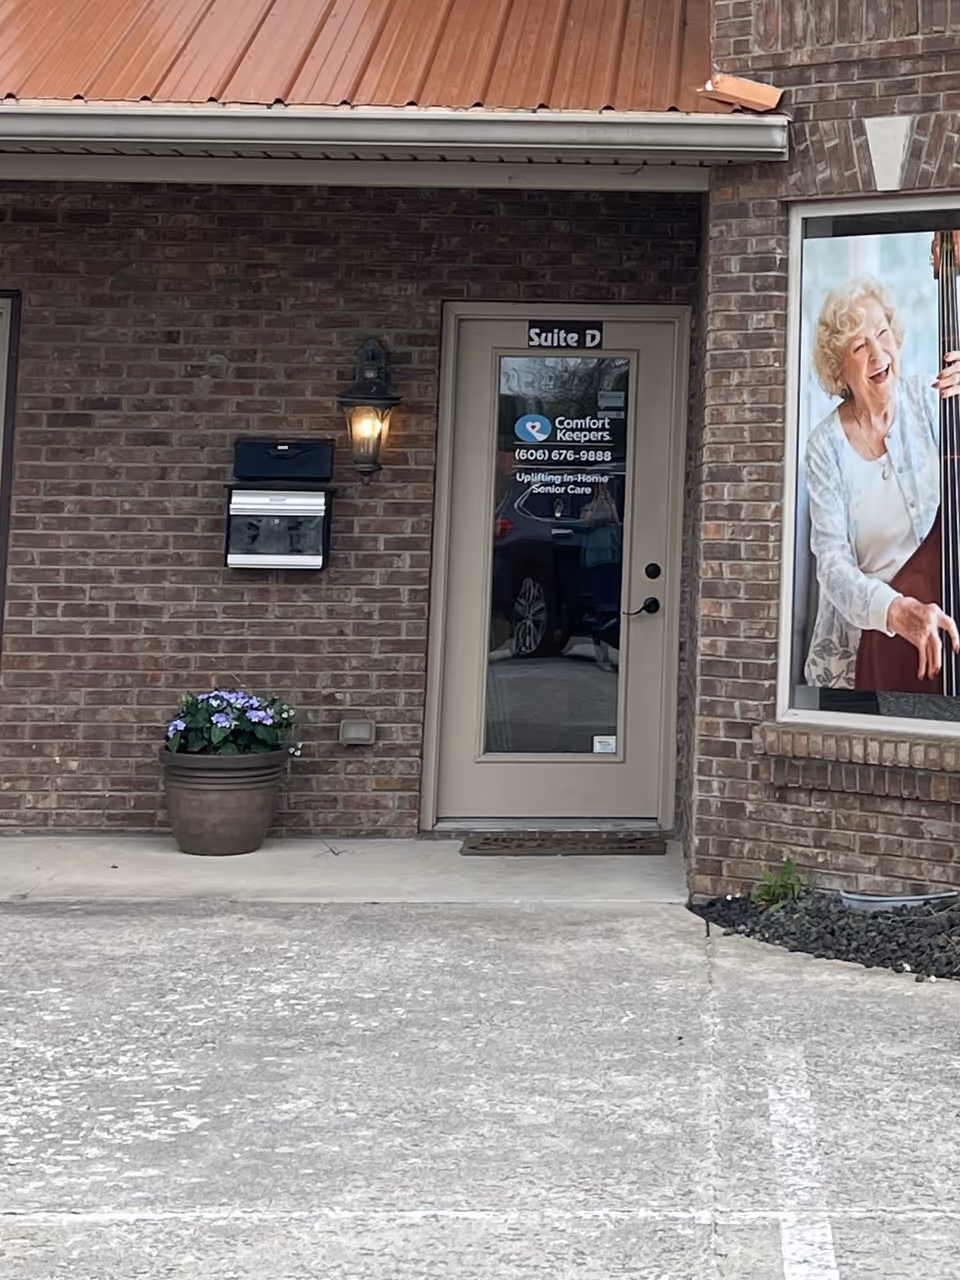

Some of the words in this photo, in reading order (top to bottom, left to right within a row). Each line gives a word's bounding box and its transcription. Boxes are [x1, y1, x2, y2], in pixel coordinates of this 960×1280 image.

[528, 328, 579, 347] Suite
[585, 329, 601, 347] D
[555, 416, 610, 429] Comfort
[514, 449, 549, 461] (606)
[551, 450, 612, 462] 676-9888
[516, 472, 562, 485] Uplifting
[563, 474, 609, 484] In-Home
[532, 484, 566, 494] Senior
[567, 485, 592, 495] Care
